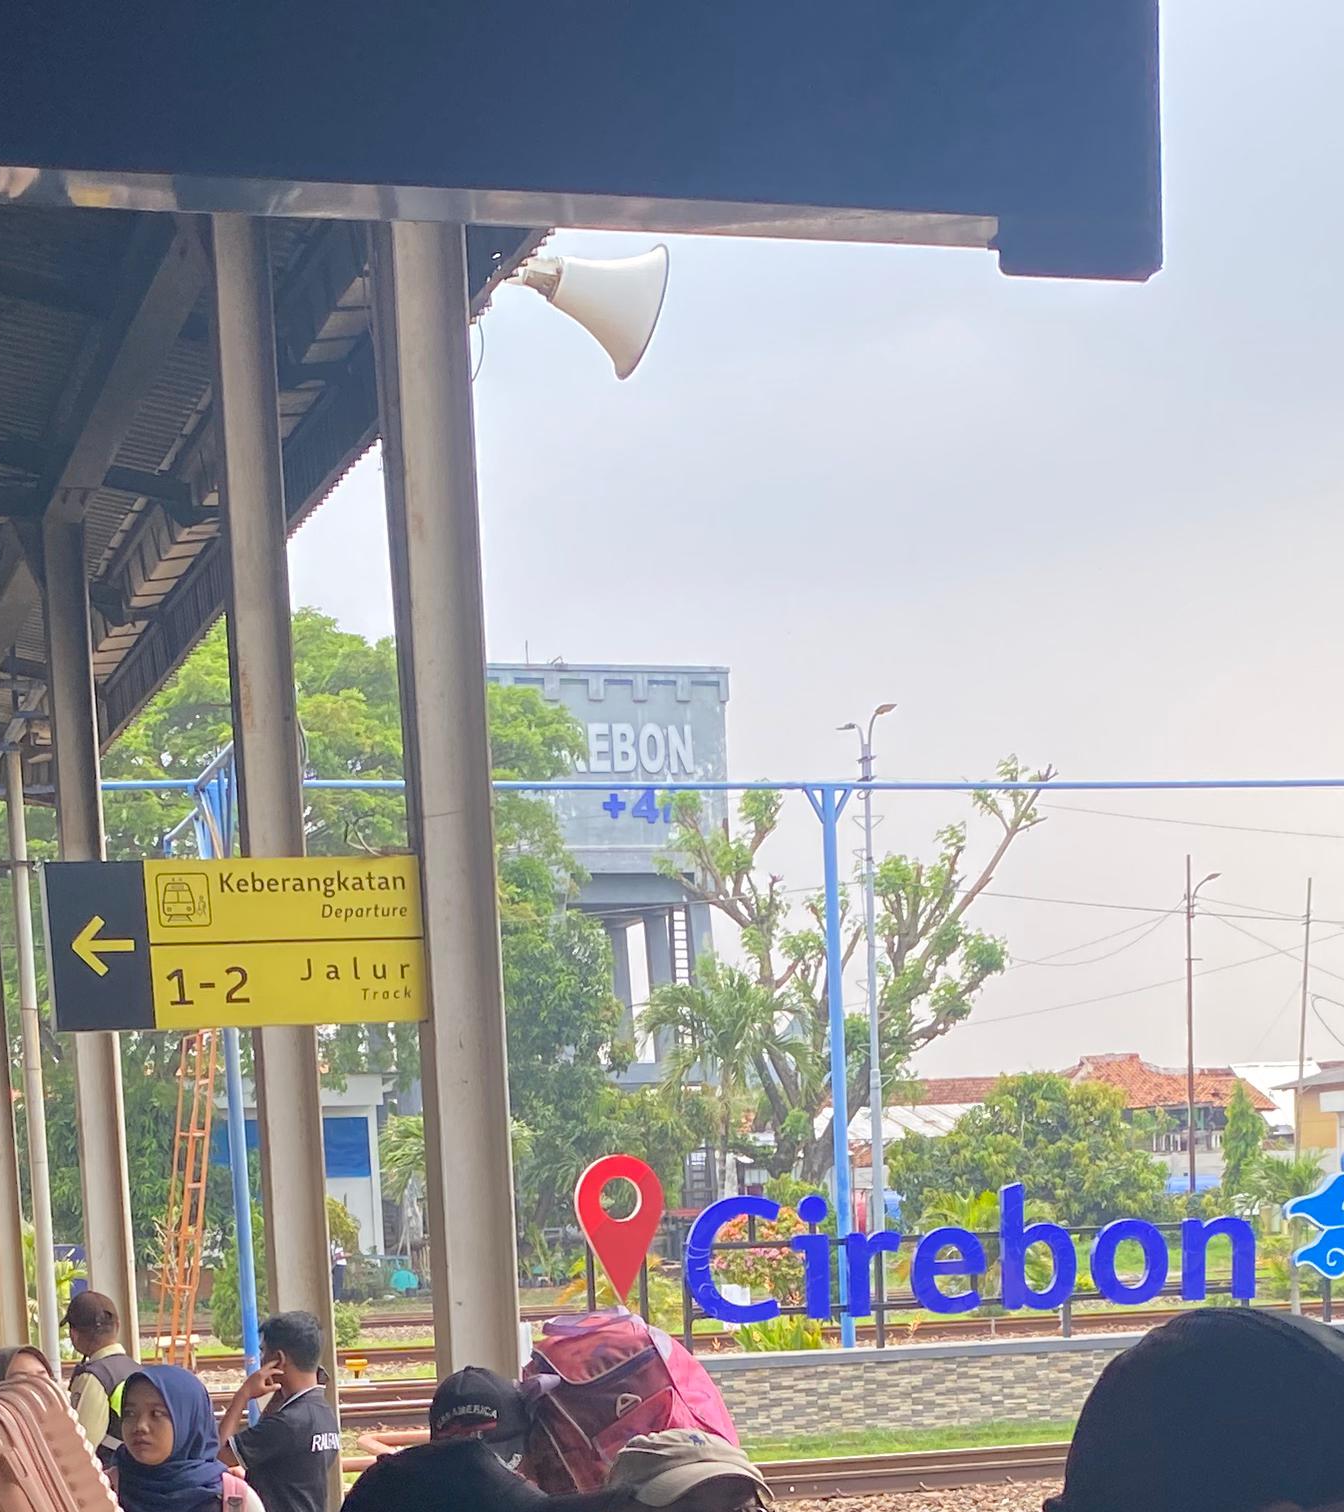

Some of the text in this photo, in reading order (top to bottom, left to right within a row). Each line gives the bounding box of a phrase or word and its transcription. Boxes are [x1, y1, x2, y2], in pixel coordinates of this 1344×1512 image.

[218, 870, 407, 897] Keberangkatan
[320, 903, 408, 922] Departure
[299, 957, 412, 982] Jalur
[165, 966, 251, 1006] 1-2
[361, 986, 412, 1001] Track
[684, 1181, 1257, 1323] Cirebon
